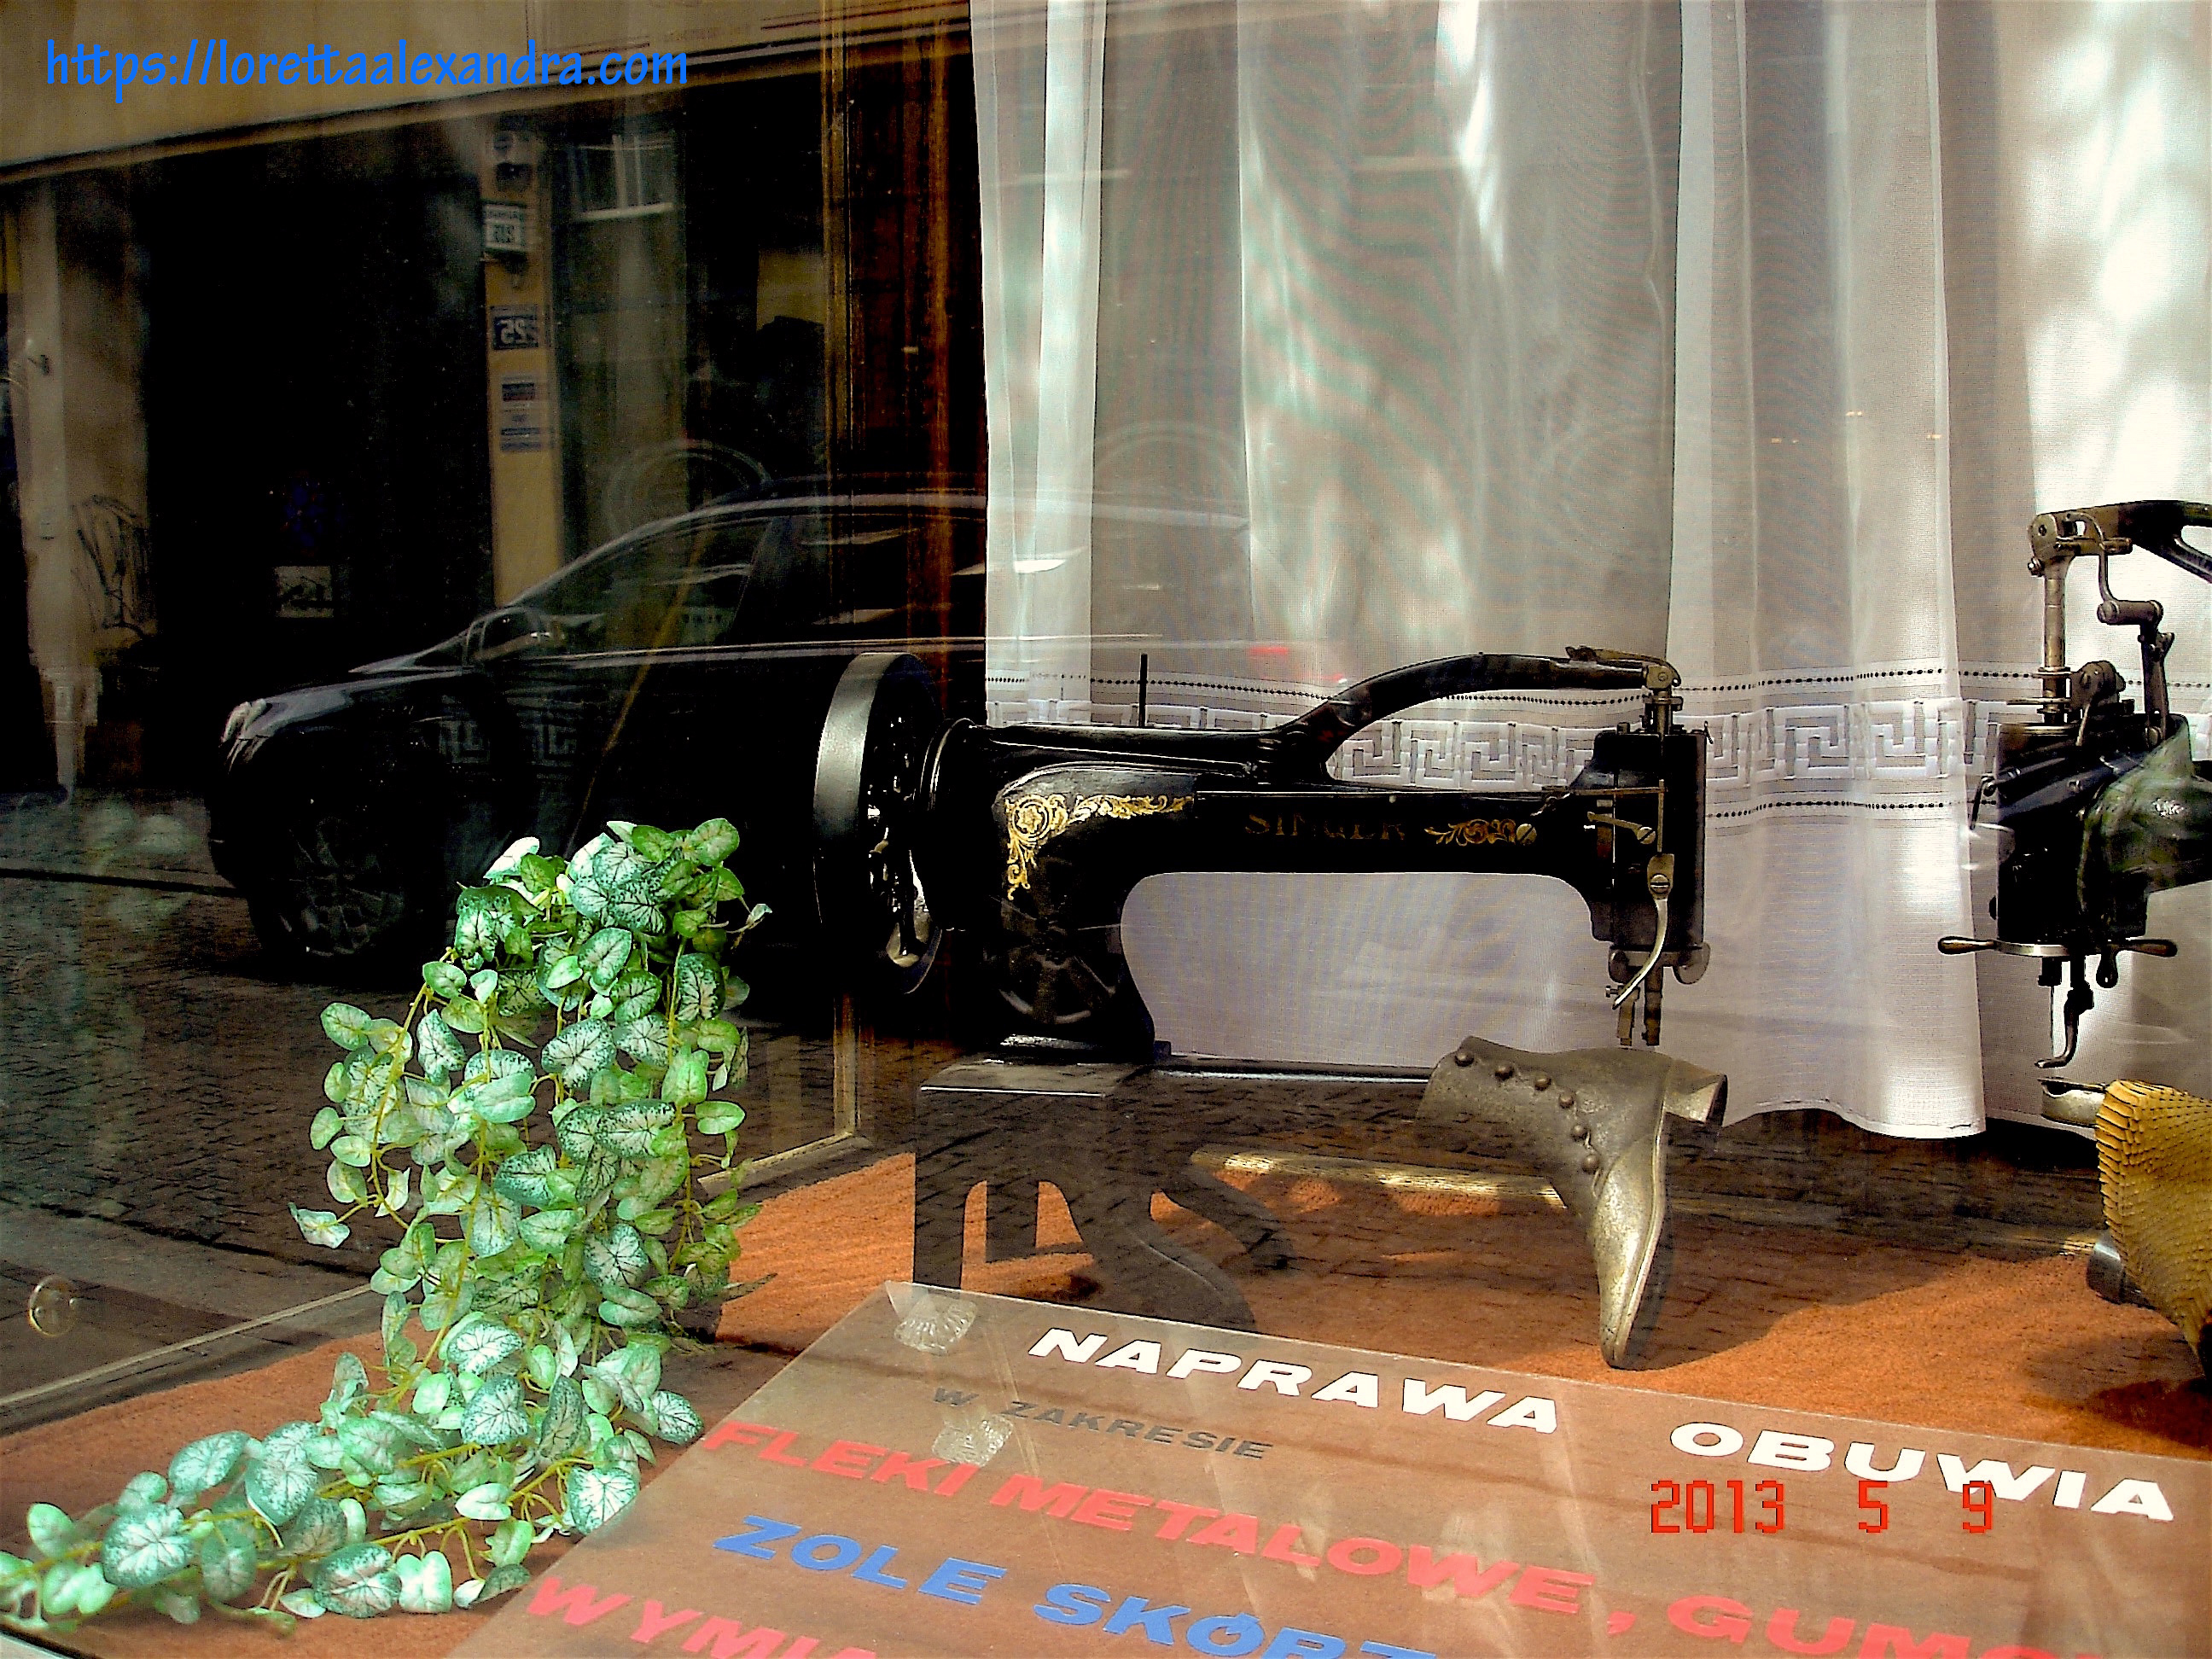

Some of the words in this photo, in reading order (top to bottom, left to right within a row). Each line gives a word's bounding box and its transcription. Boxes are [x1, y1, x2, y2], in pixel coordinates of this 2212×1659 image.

[703, 1420, 977, 1497] FLEKI
[934, 1387, 981, 1408] W
[1009, 1400, 1273, 1460] ZAKRESIE
[1028, 1327, 1558, 1435] NAPRAWA
[1669, 1422, 2174, 1521] OBUWIA
[712, 1514, 1007, 1606] ZOLE
